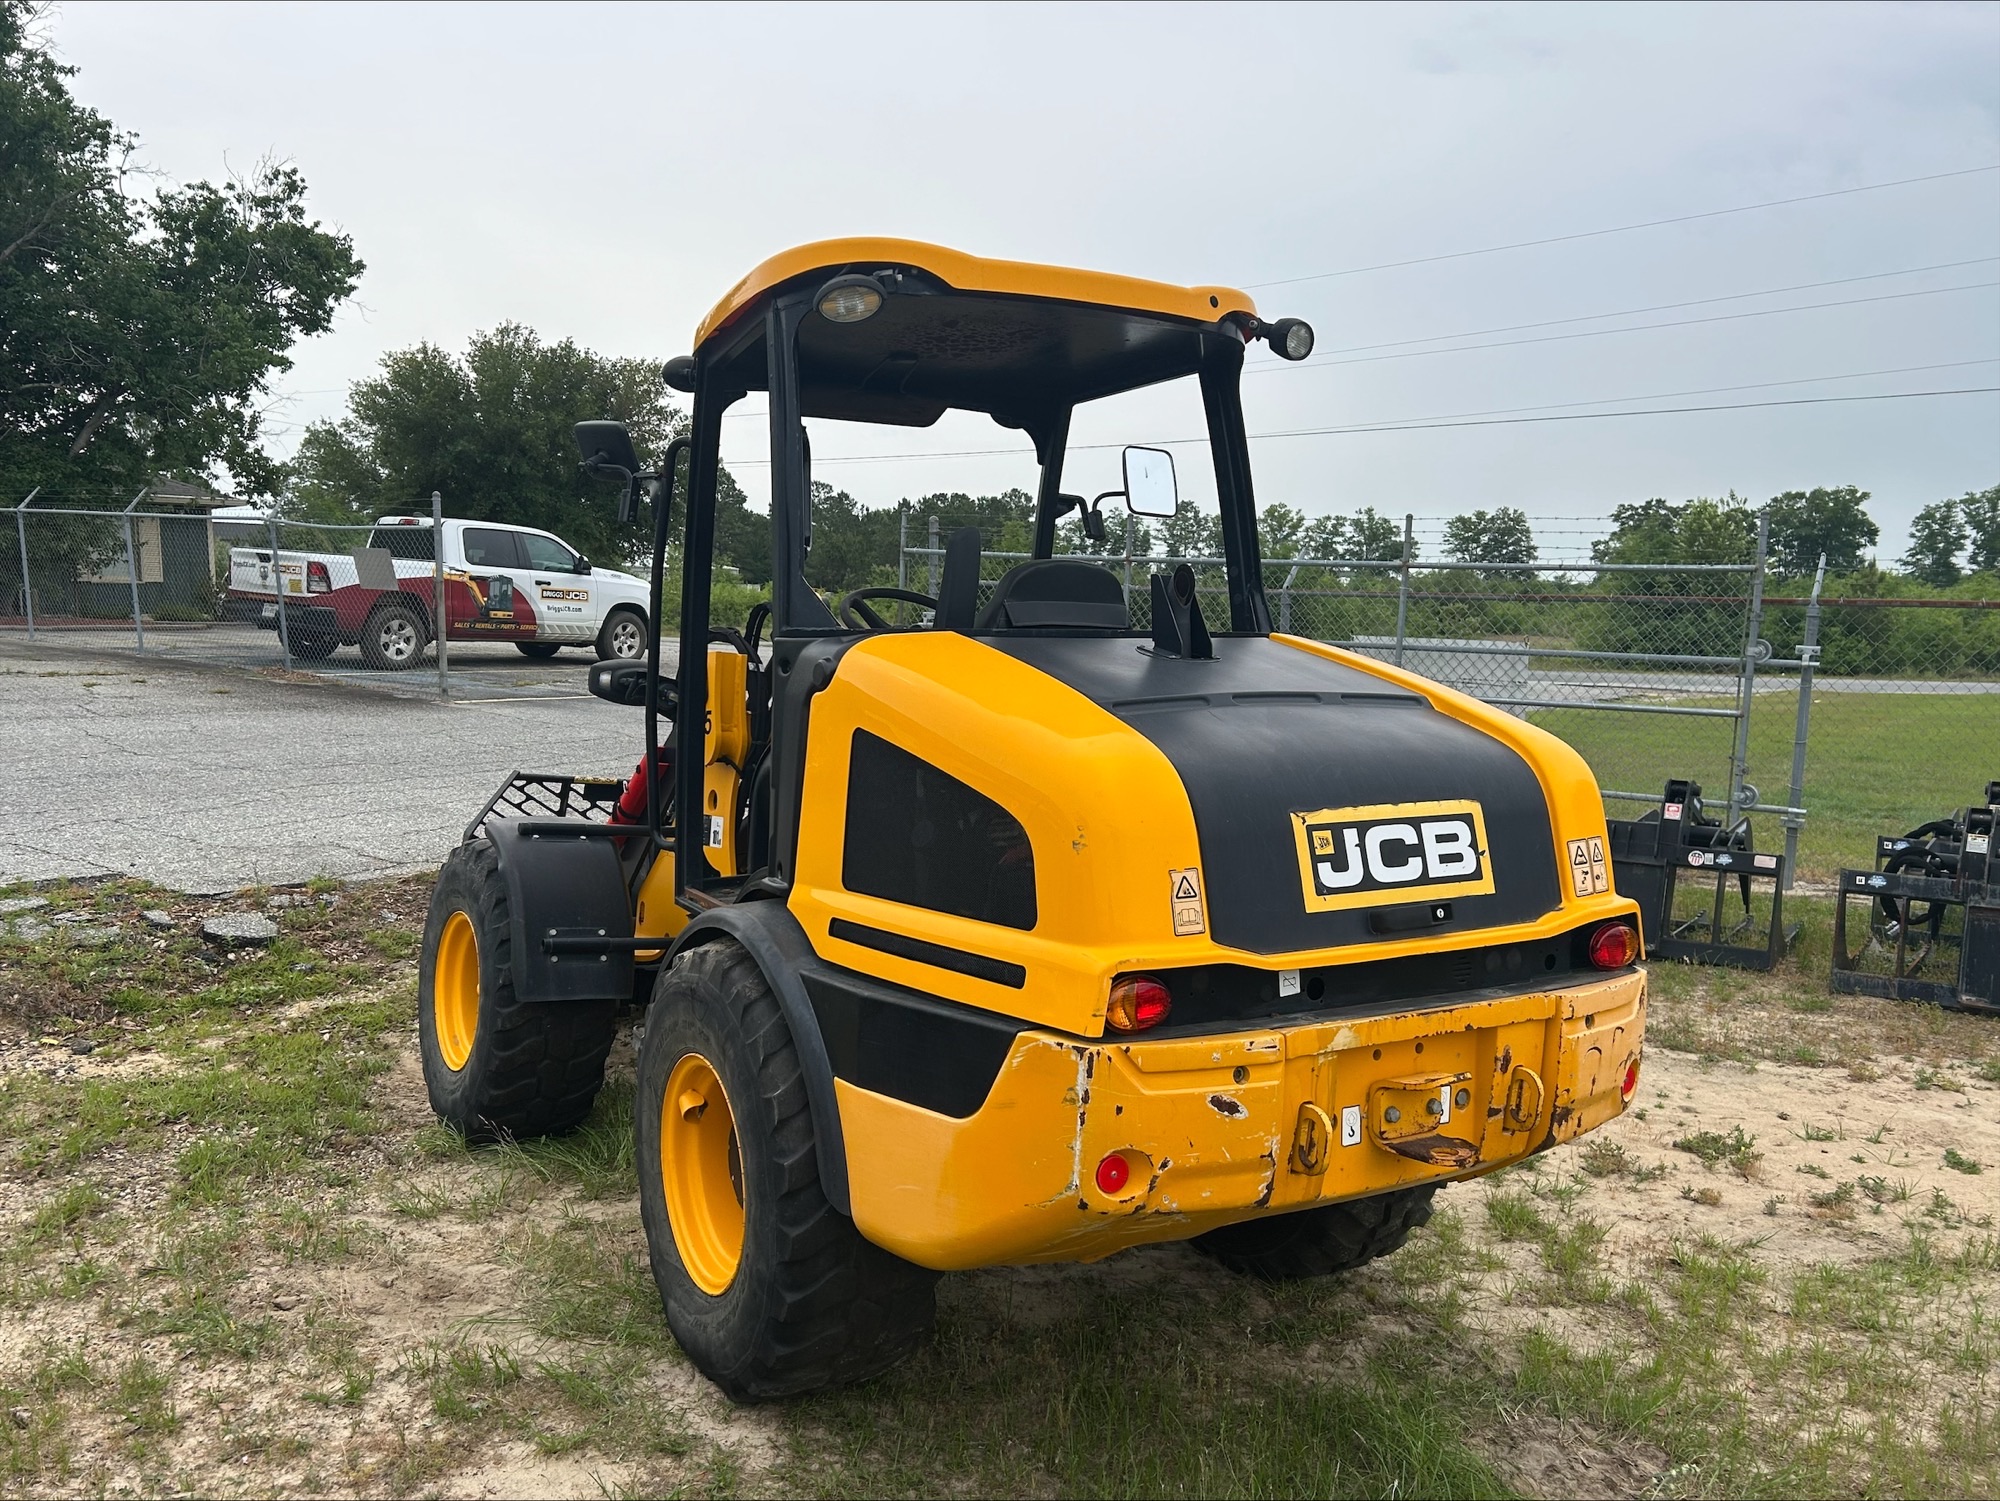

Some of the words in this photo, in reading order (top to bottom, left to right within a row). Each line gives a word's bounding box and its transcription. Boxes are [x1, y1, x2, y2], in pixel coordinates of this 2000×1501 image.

[542, 590, 563, 598] BRIGGS
[565, 591, 588, 600] JCB
[453, 621, 470, 629] SALES
[474, 622, 496, 630] RENTALS
[1317, 820, 1477, 888] JCB
